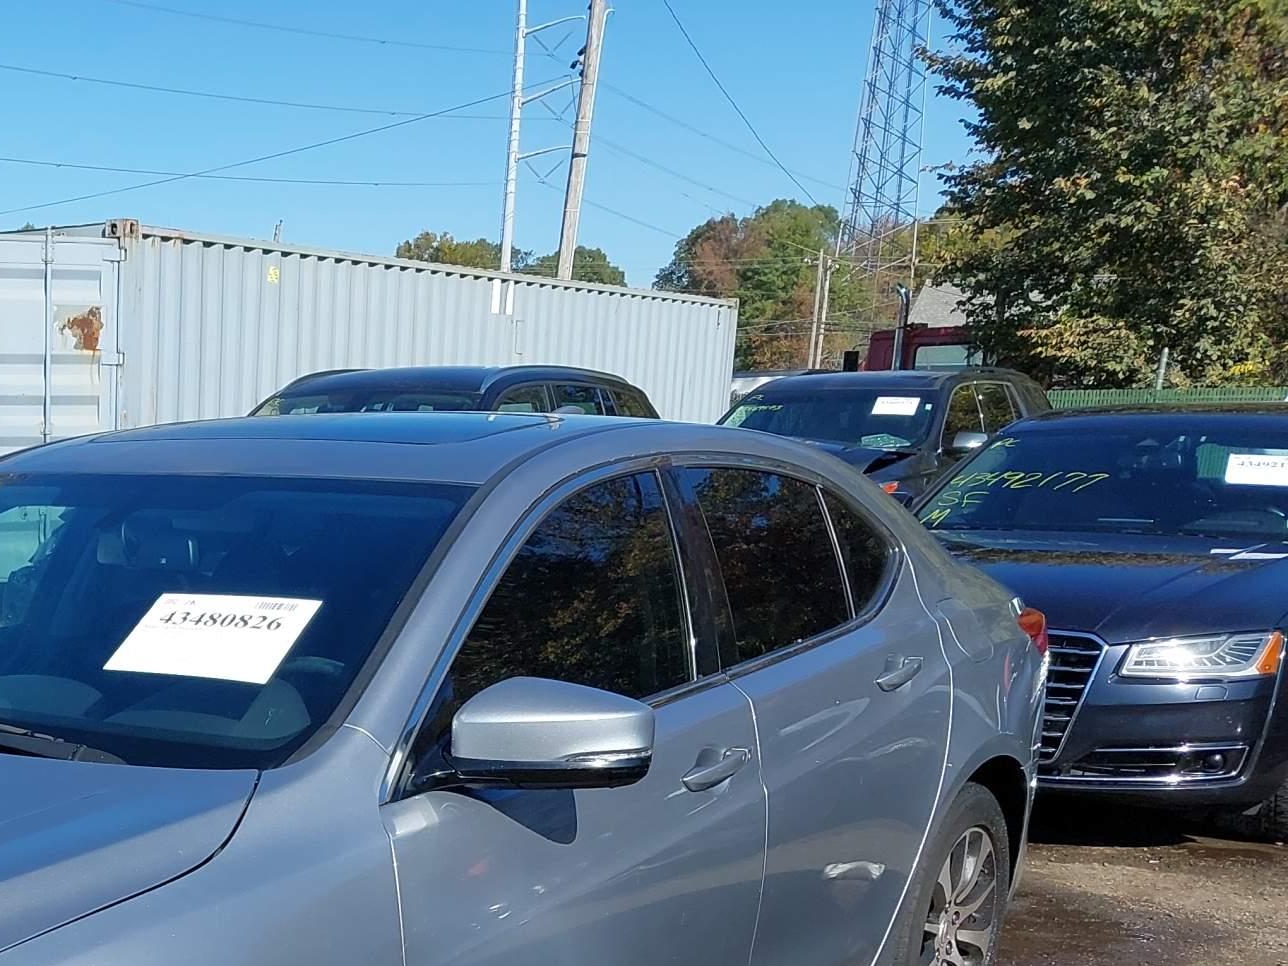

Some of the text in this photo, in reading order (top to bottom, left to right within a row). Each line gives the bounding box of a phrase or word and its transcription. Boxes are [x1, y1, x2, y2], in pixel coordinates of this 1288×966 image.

[949, 470, 1111, 493] 43492177
[937, 490, 990, 508] SF
[159, 610, 285, 631] 43480826
